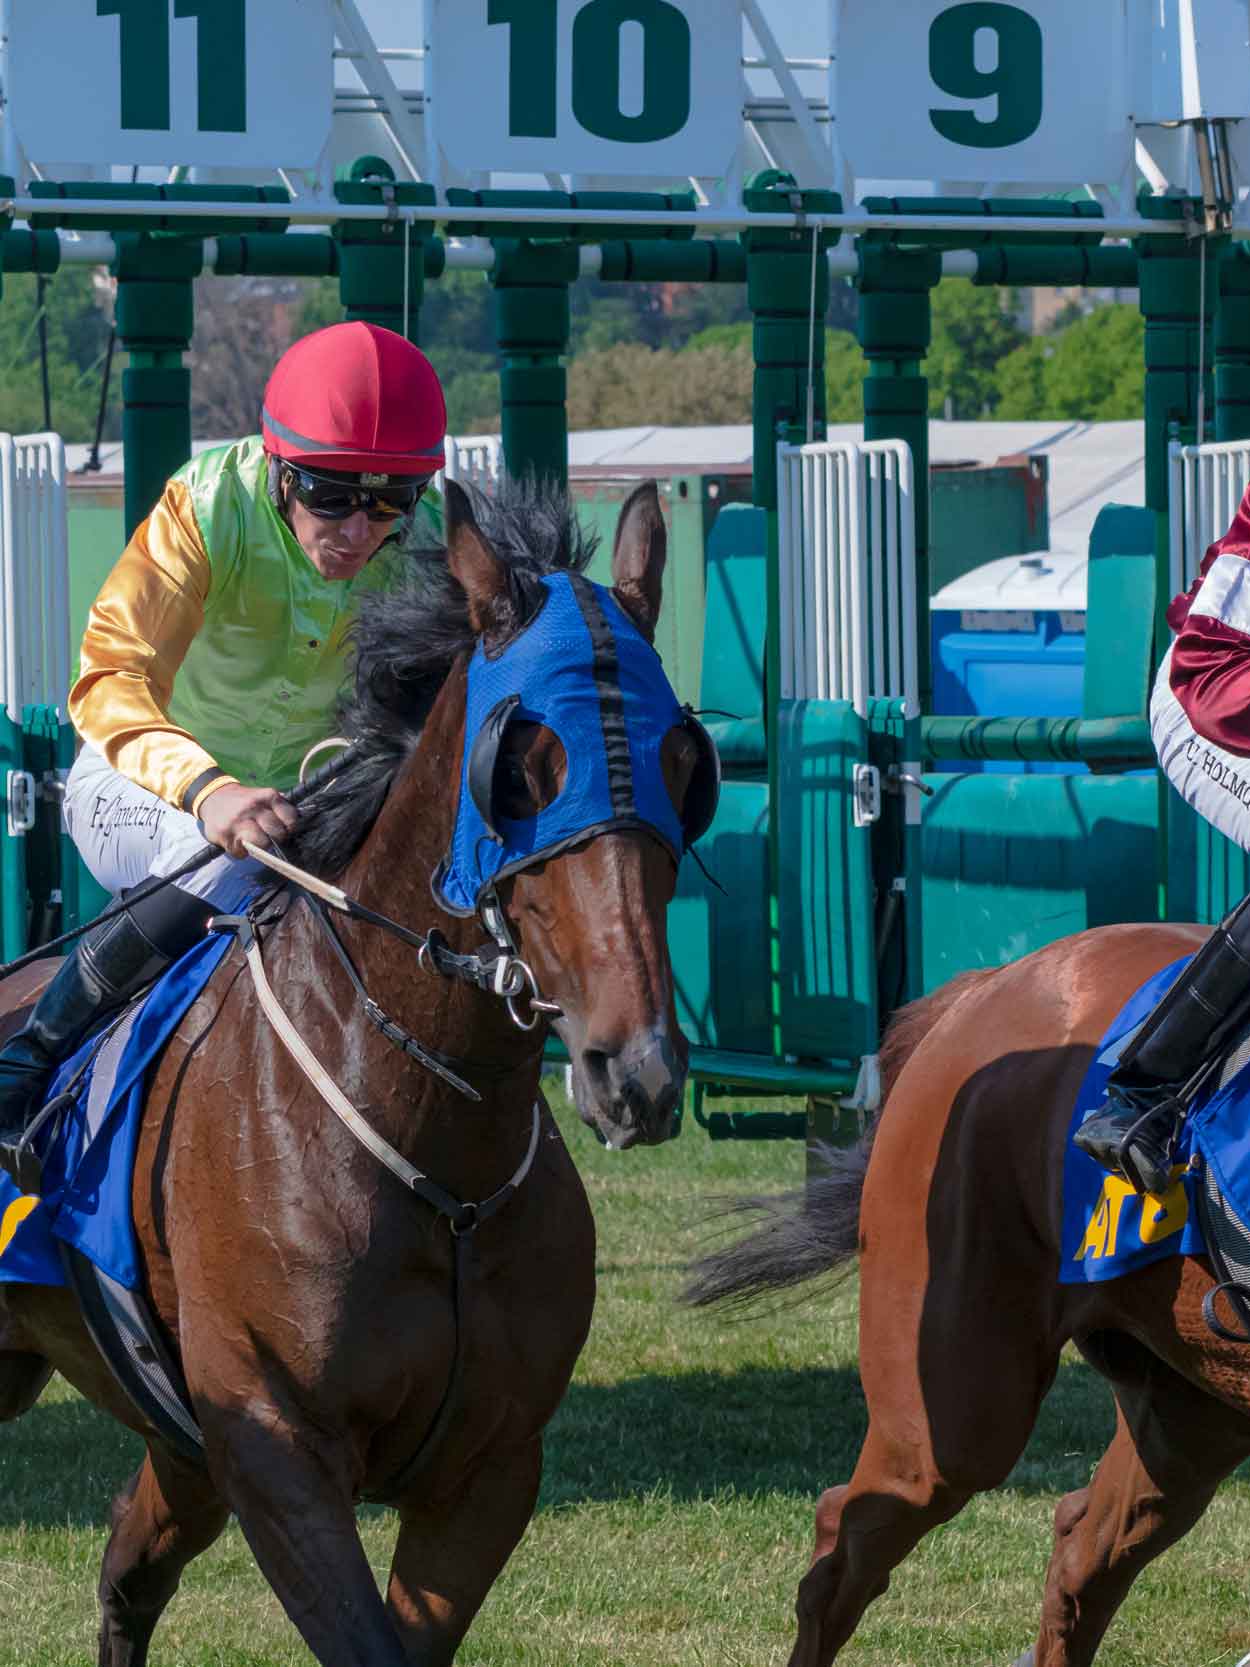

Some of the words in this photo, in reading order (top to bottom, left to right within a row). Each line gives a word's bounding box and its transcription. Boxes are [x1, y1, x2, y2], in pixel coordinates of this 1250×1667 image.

[96, 0, 246, 133] 11
[487, 0, 690, 143] 10
[928, 1, 1043, 149] 9
